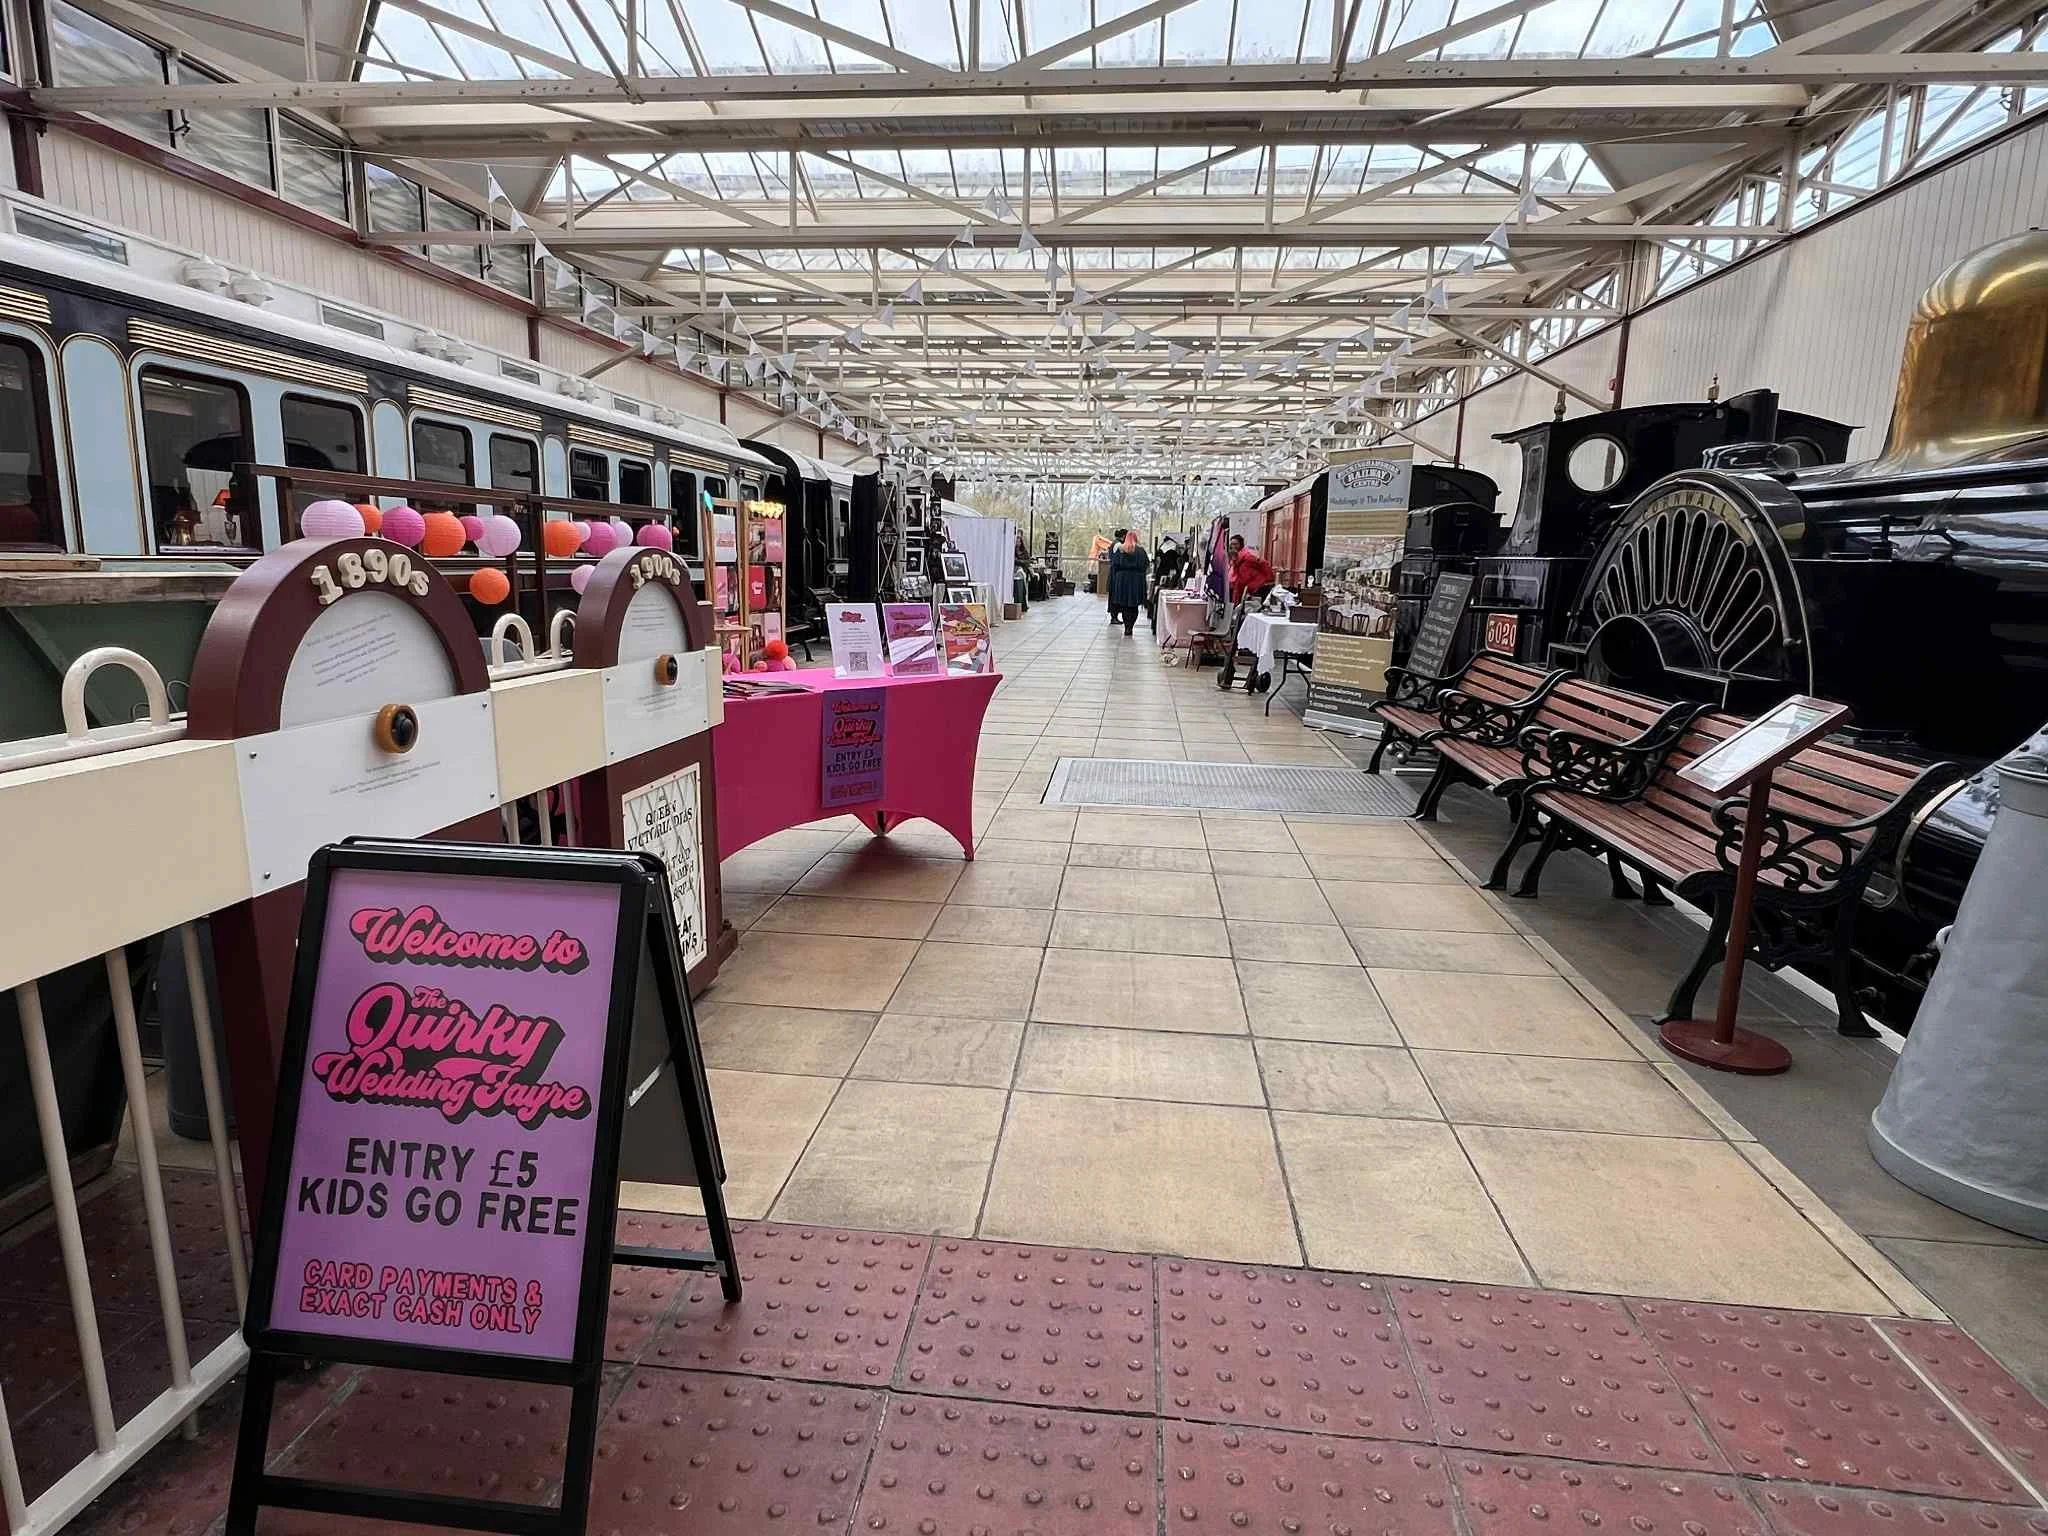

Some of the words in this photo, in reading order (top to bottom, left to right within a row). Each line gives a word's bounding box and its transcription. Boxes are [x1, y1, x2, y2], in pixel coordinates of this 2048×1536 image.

[1347, 468, 1386, 482] RAILWAY
[1640, 491, 1728, 520] CORNWALL
[311, 548, 430, 605] 1890s
[630, 554, 680, 589] 1900s
[849, 759, 860, 770] GO
[863, 757, 881, 769] FREE
[350, 905, 541, 972] Welcome
[542, 930, 590, 975] to
[411, 985, 447, 1010] The
[346, 981, 564, 1076] Quirky
[312, 1047, 476, 1122] Wedding
[473, 1060, 592, 1130] Fayre
[345, 1137, 476, 1183] ENTRY
[488, 1149, 539, 1189] £5
[298, 1176, 389, 1219] KIDS
[405, 1186, 462, 1227] GO
[477, 1191, 580, 1237] FREE
[303, 1258, 373, 1290] CARD
[381, 1265, 517, 1305] PAYMENTS
[524, 1280, 543, 1308] &
[299, 1285, 387, 1320] EXACT
[393, 1296, 464, 1327] CASH
[470, 1303, 542, 1335] ONLY
